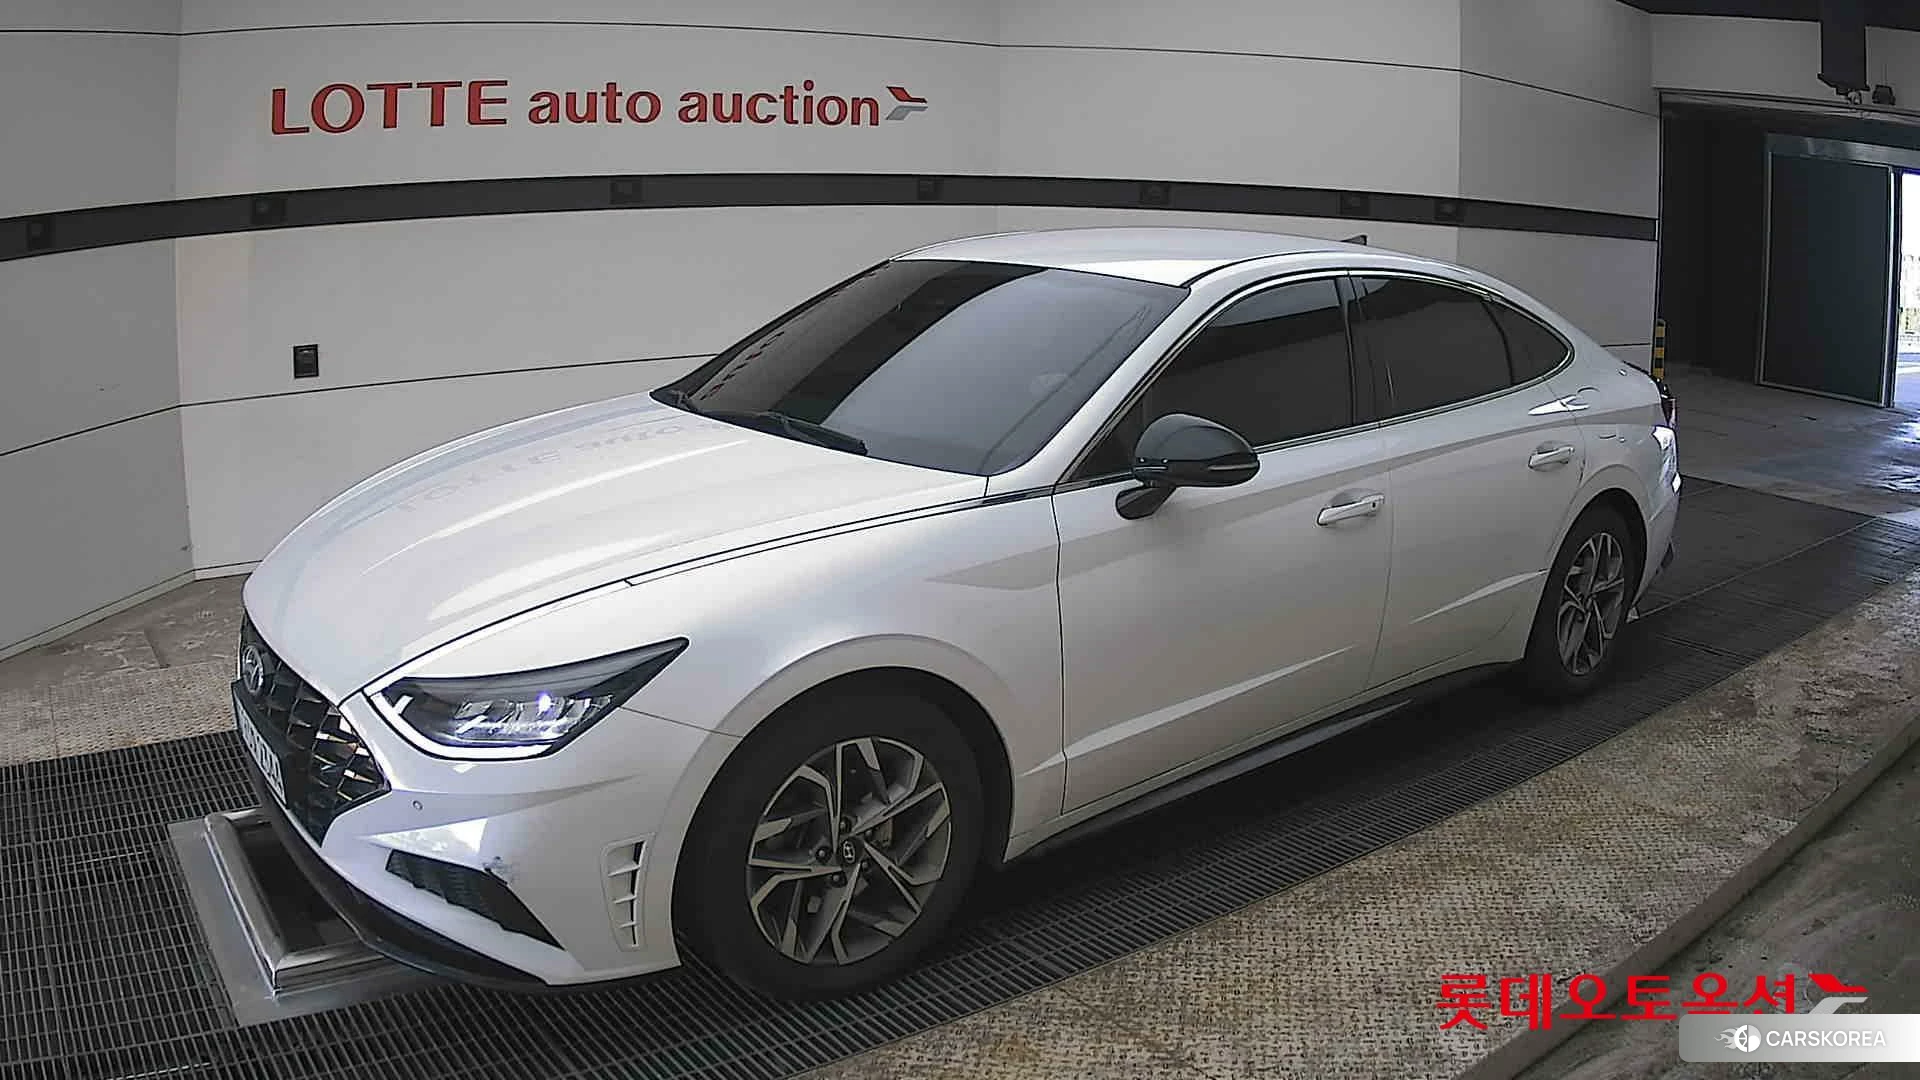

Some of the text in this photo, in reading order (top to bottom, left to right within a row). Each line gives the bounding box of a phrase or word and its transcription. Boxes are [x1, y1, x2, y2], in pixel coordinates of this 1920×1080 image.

[271, 79, 880, 135] LOTTE auto auction
